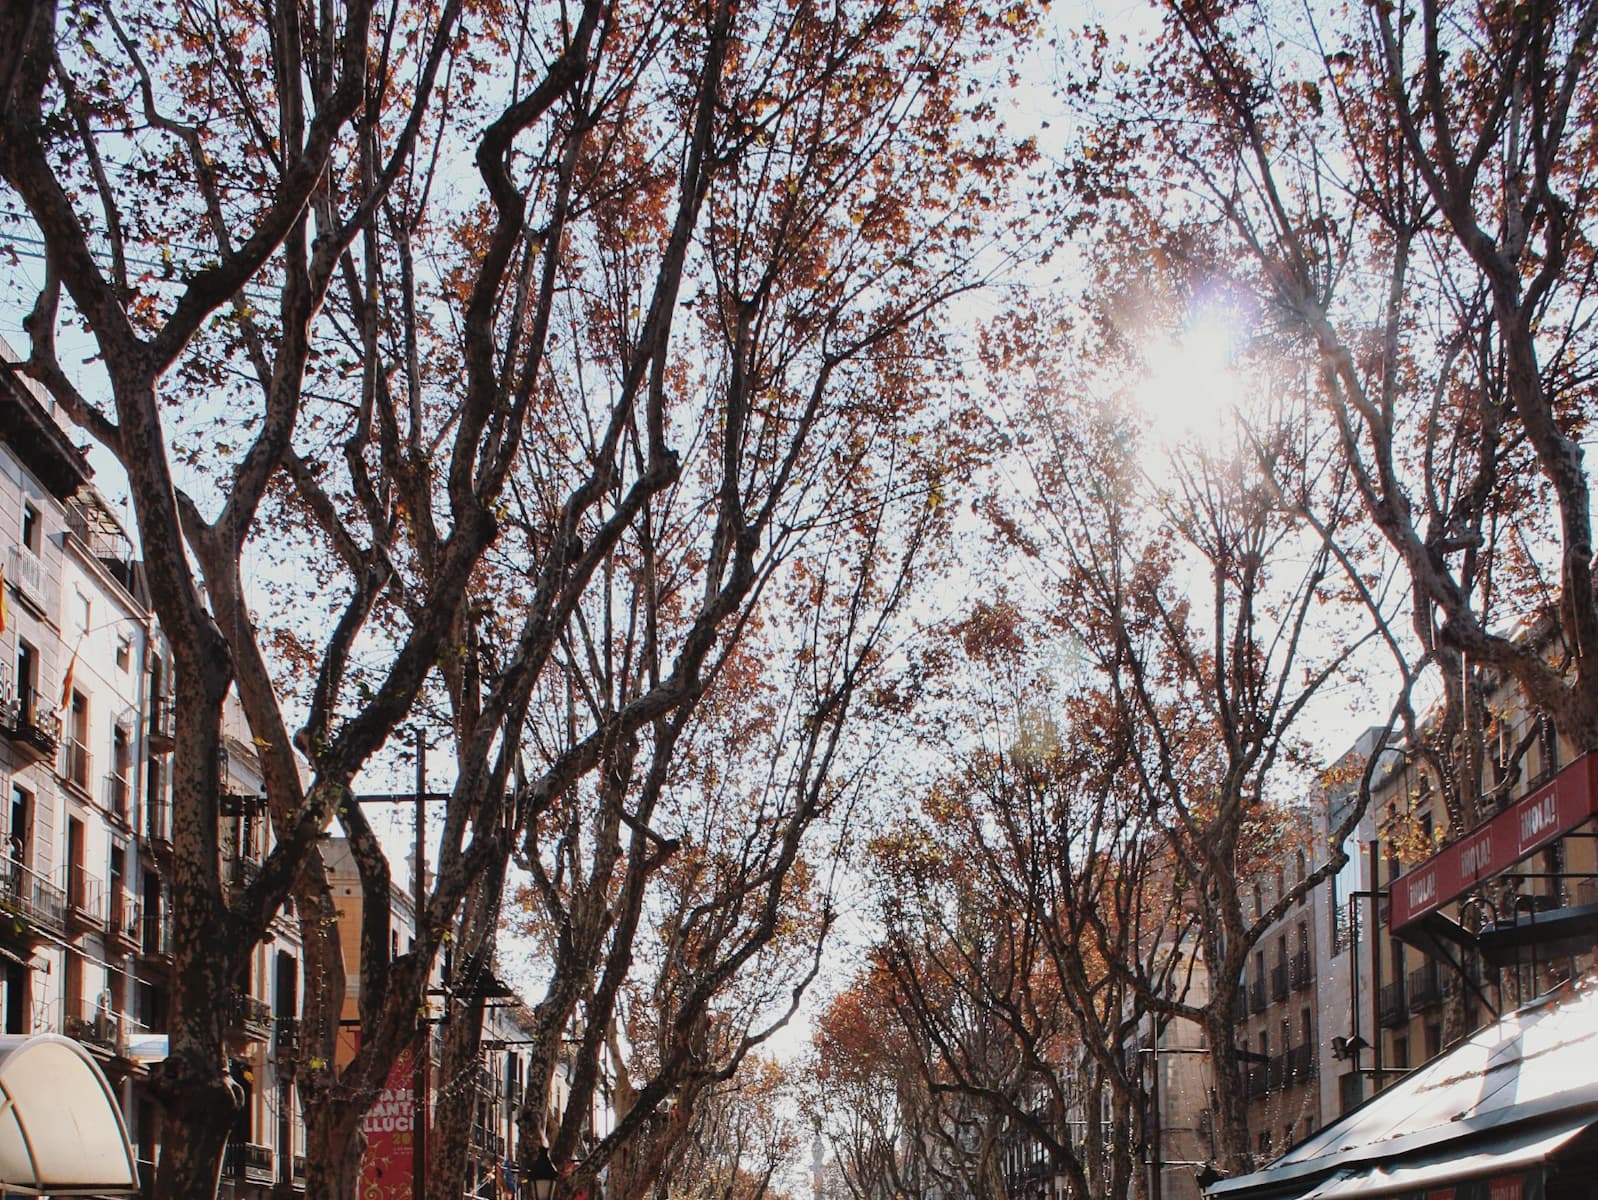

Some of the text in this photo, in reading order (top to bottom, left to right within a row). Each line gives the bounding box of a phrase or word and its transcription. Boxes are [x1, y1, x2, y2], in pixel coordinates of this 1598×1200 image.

[1521, 793, 1556, 841] ¡HOLA!
[1461, 837, 1490, 878] ¡HOLA!
[1409, 872, 1435, 909] ¡HOLA!
